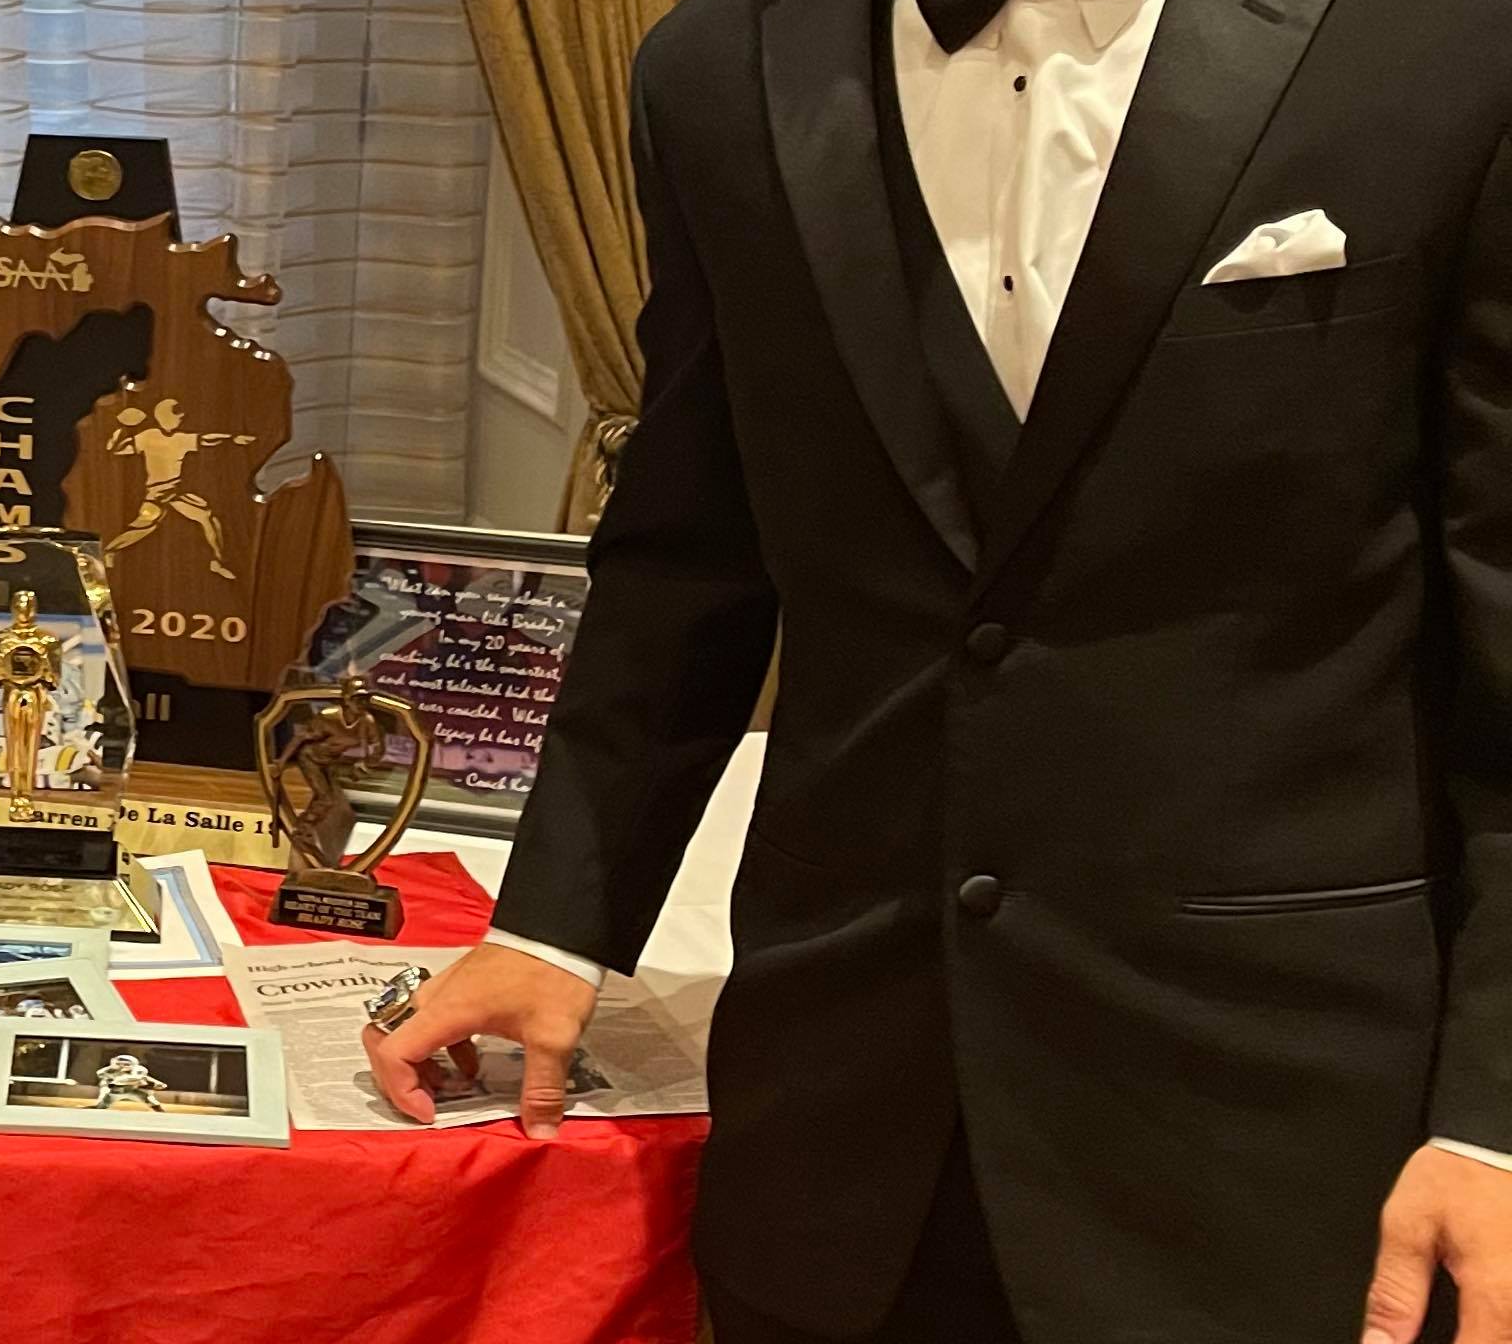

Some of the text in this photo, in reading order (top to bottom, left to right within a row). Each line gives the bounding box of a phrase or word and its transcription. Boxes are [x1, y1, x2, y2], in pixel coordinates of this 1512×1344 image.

[130, 608, 248, 643] 2020
[484, 635, 506, 651] 20
[31, 809, 99, 829] arren
[146, 807, 177, 826] La
[184, 811, 245, 833] Salle
[256, 971, 390, 998] Crownin
